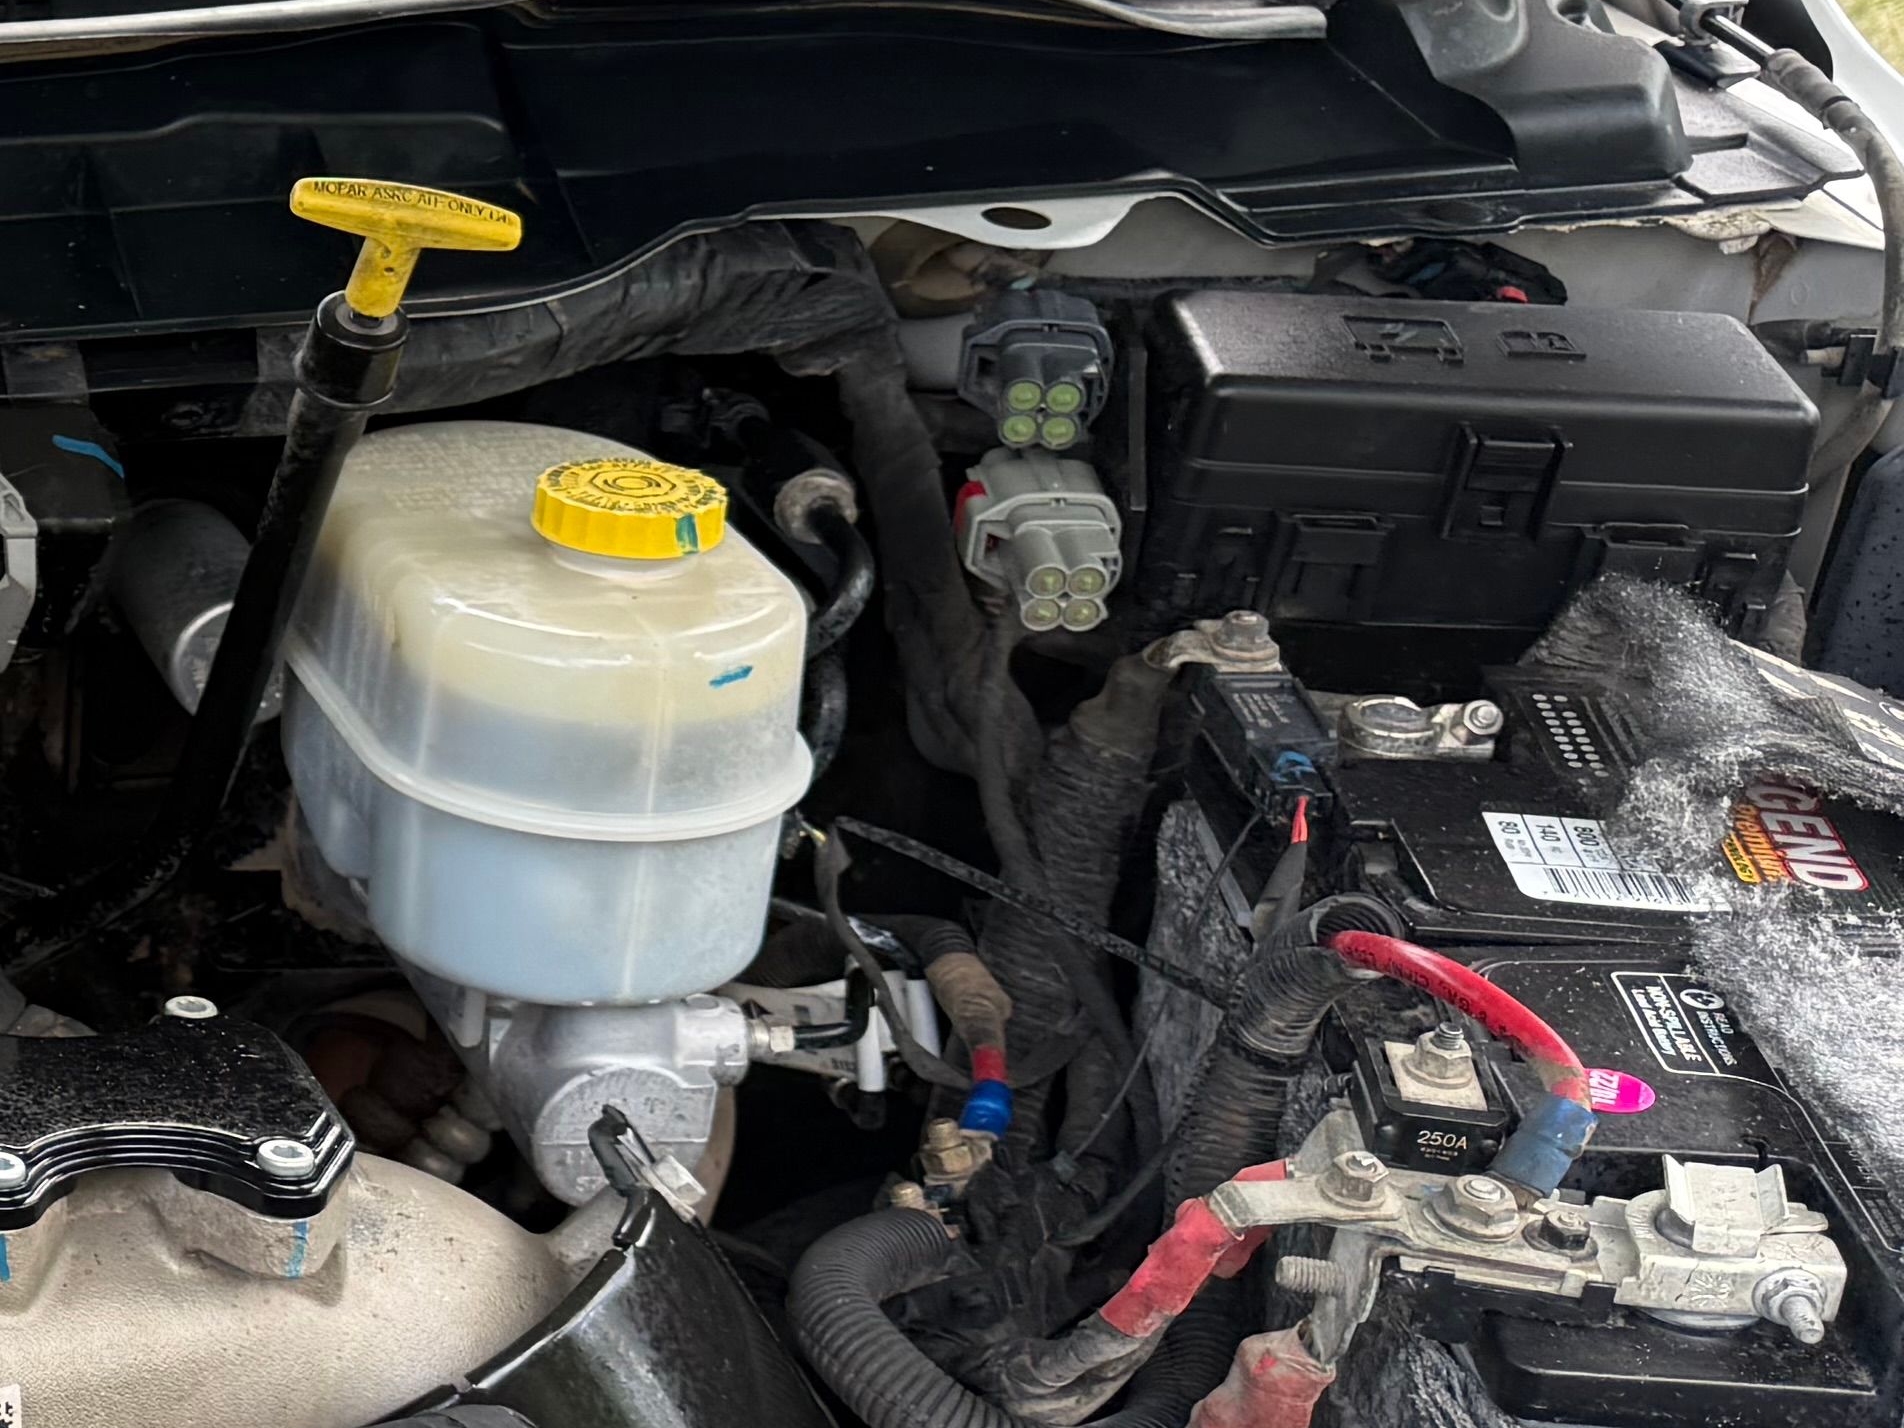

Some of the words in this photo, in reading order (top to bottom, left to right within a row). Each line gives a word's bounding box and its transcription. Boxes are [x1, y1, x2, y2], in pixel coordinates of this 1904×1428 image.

[314, 181, 367, 197] MOPAR
[1746, 780, 1870, 892] GEND
[1644, 984, 1702, 1063] NON-SPILLABLE
[1416, 1130, 1467, 1150] 250A
